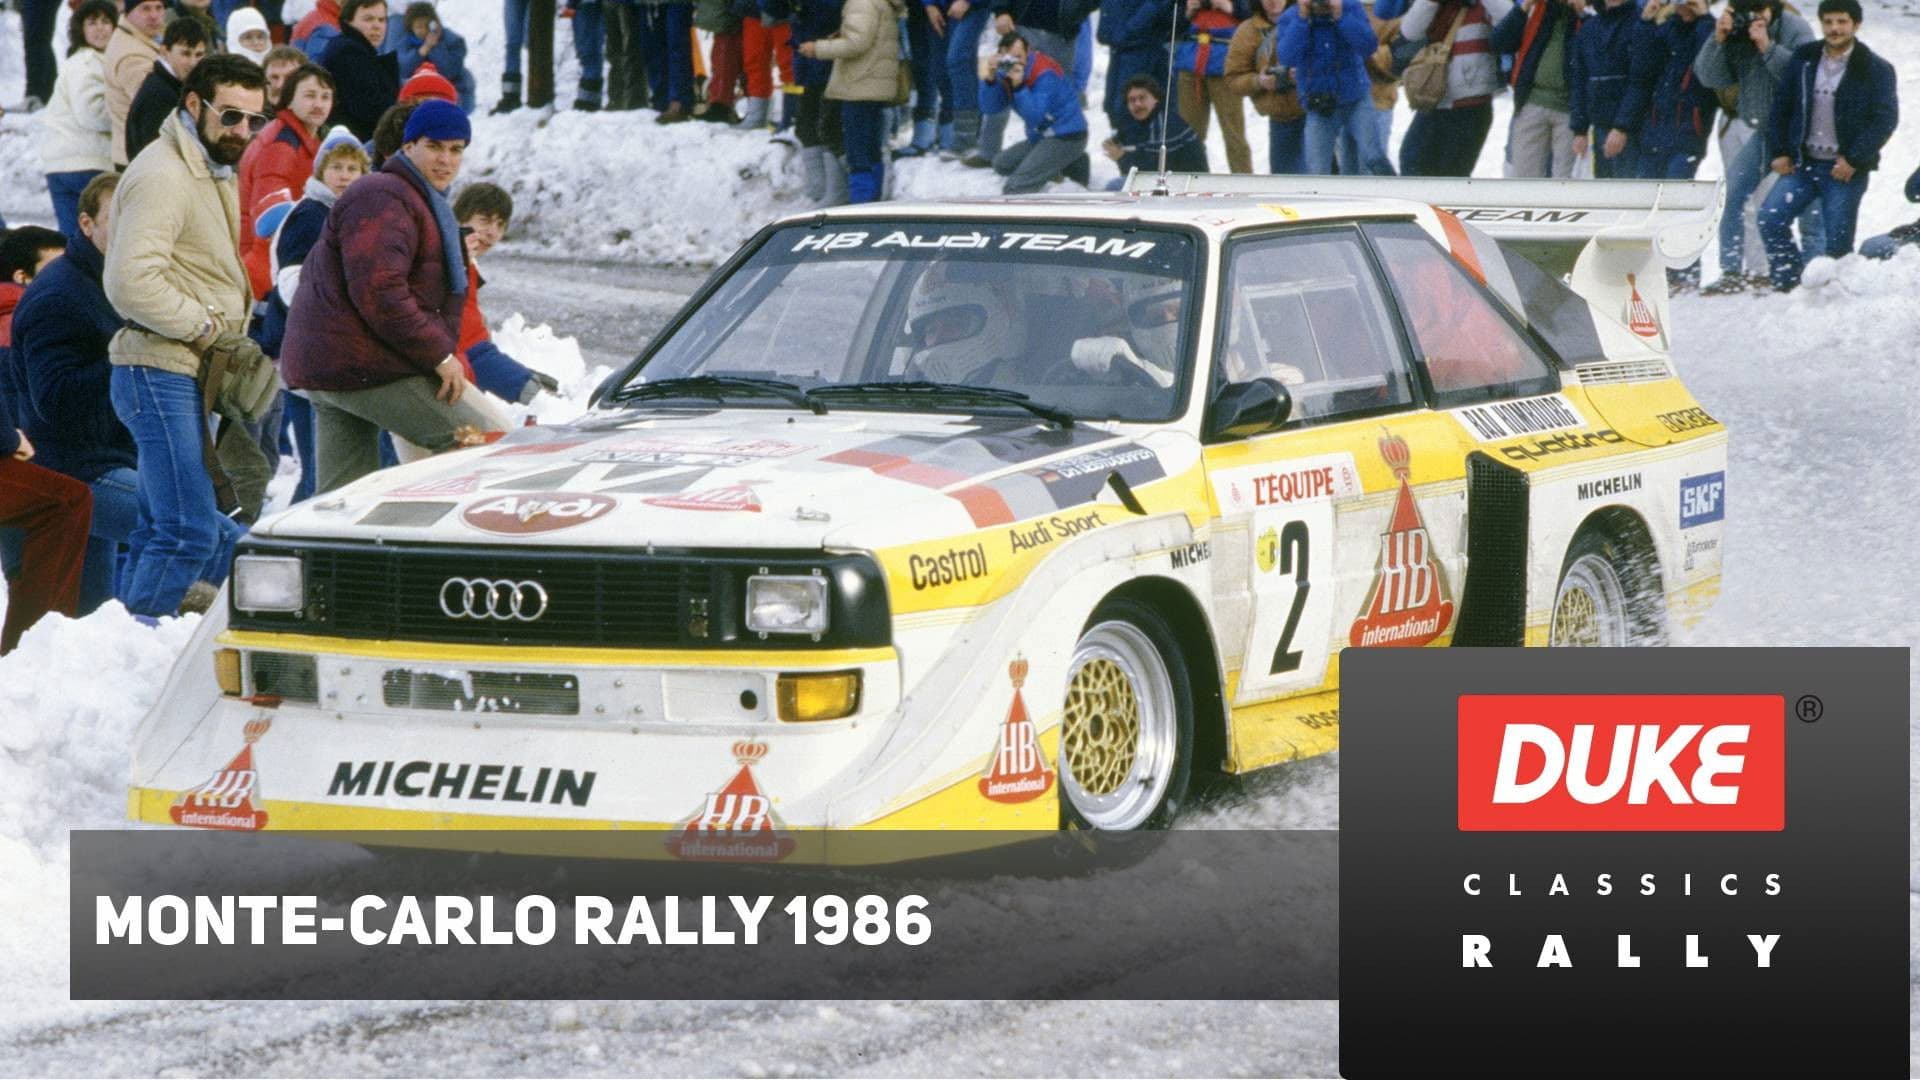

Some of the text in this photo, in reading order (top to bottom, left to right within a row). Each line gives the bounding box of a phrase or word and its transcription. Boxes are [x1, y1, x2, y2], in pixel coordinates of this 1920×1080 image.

[791, 231, 1156, 258] HB Audi TEAM
[1461, 396, 1578, 440] BAD HOMBOURG
[1500, 429, 1624, 461] quattro
[1577, 472, 1642, 500] MICHELIN
[1682, 481, 1723, 518] SKF
[1008, 511, 1106, 554] Audi Sport
[910, 543, 988, 591] Castrol
[1380, 528, 1432, 615] HB
[1269, 520, 1310, 676] 2
[1361, 613, 1439, 646] international
[1296, 709, 1340, 729] BOS
[999, 722, 1036, 776] HB
[197, 771, 257, 808] HB
[327, 761, 597, 807] MICHELIN
[988, 775, 1045, 796] international
[181, 810, 257, 829] international
[699, 793, 771, 837] HB
[681, 841, 779, 857] international
